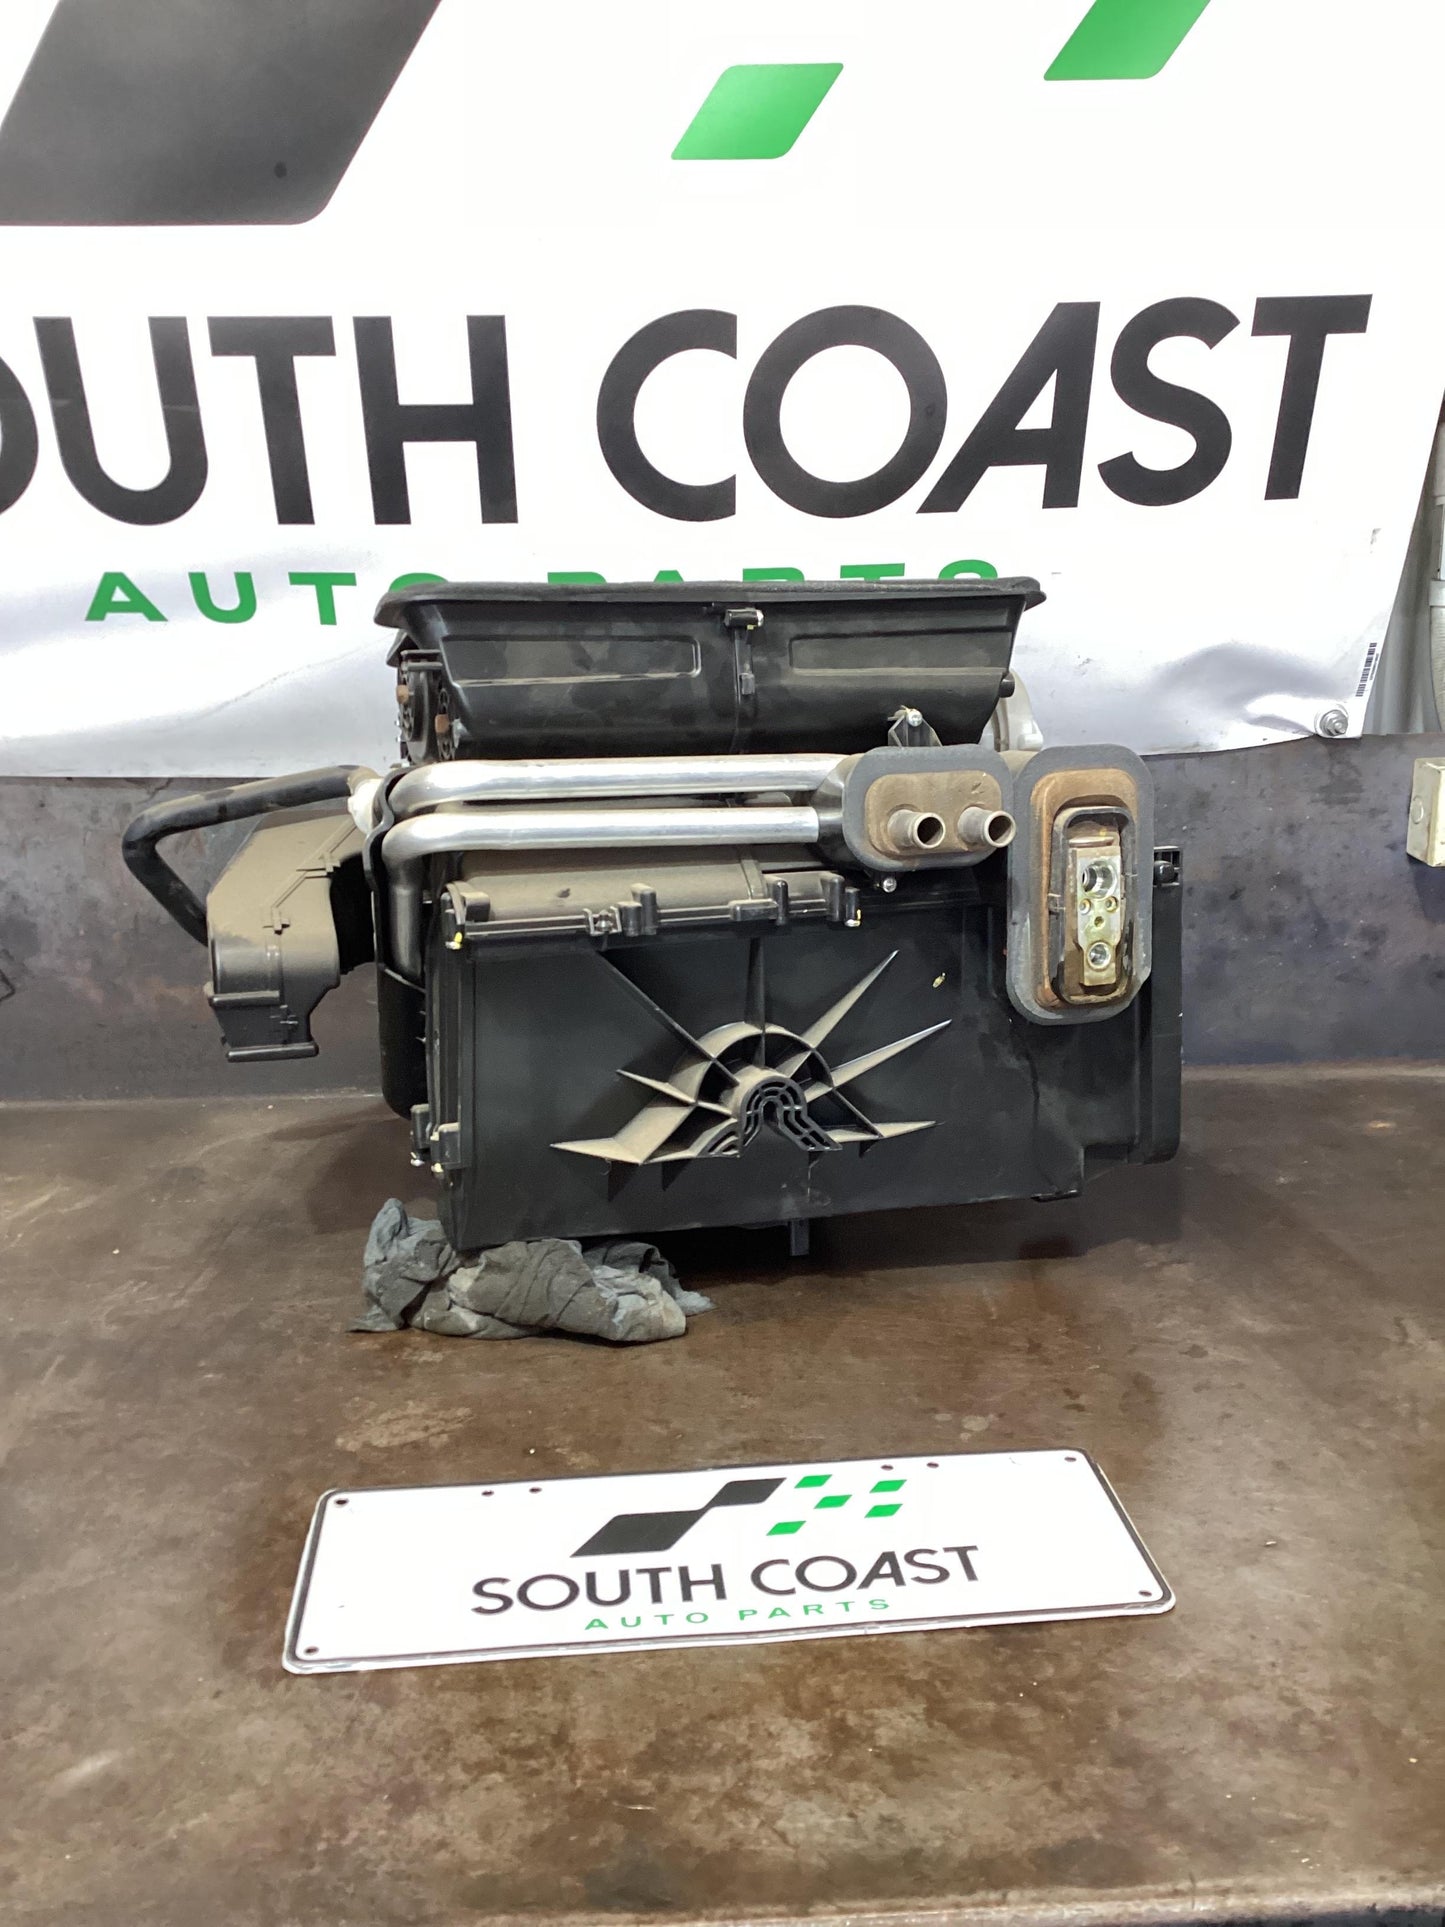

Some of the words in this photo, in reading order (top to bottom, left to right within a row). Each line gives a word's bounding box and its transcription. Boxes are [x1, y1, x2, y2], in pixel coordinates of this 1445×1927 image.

[0, 315, 519, 526] UTH
[597, 294, 1372, 522] COAST
[471, 1563, 727, 1615] SOUTH
[750, 1545, 980, 1596] COAST
[584, 1612, 709, 1631] AUTO
[738, 1598, 890, 1621] PARTS
